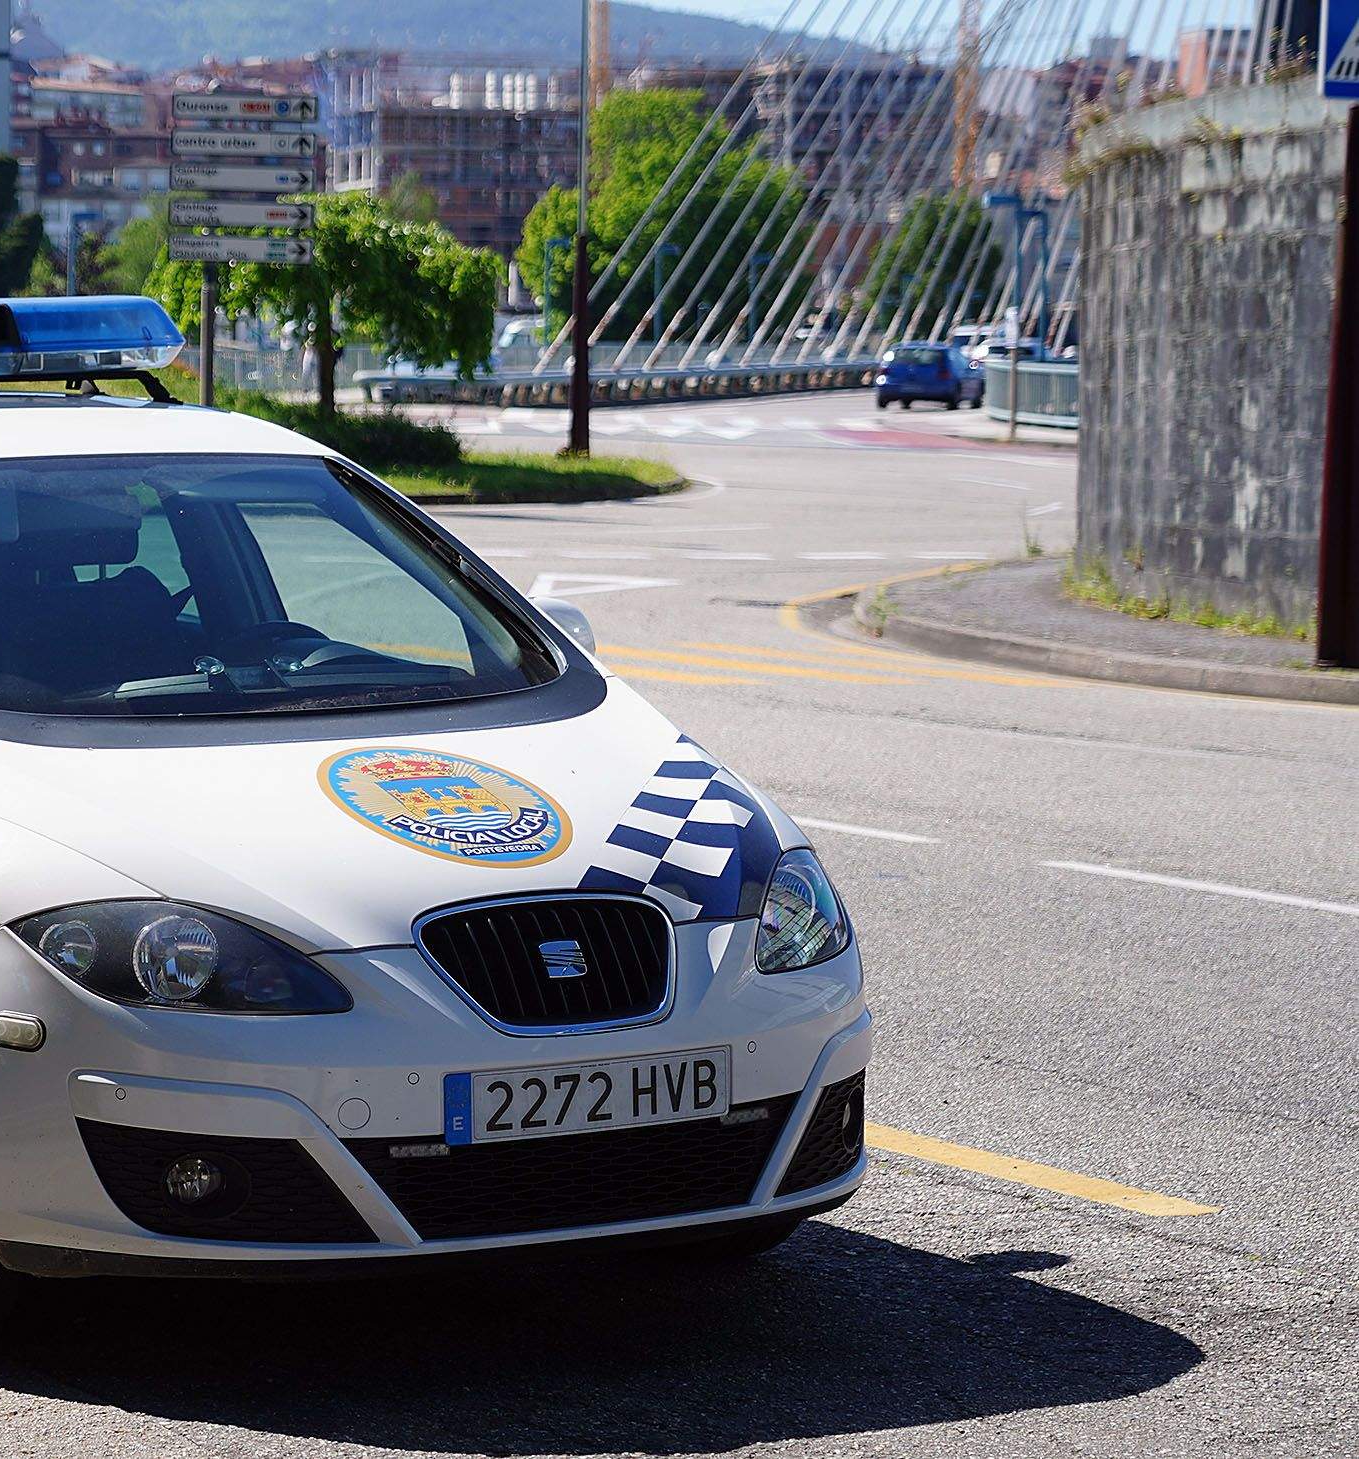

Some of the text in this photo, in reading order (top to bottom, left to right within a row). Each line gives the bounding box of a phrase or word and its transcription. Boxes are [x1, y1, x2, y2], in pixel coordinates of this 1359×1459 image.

[497, 809, 547, 843] LOCAL
[463, 844, 542, 857] PONTEVEDRA
[485, 1059, 718, 1133] 2272 HVB
[452, 1115, 465, 1132] E
